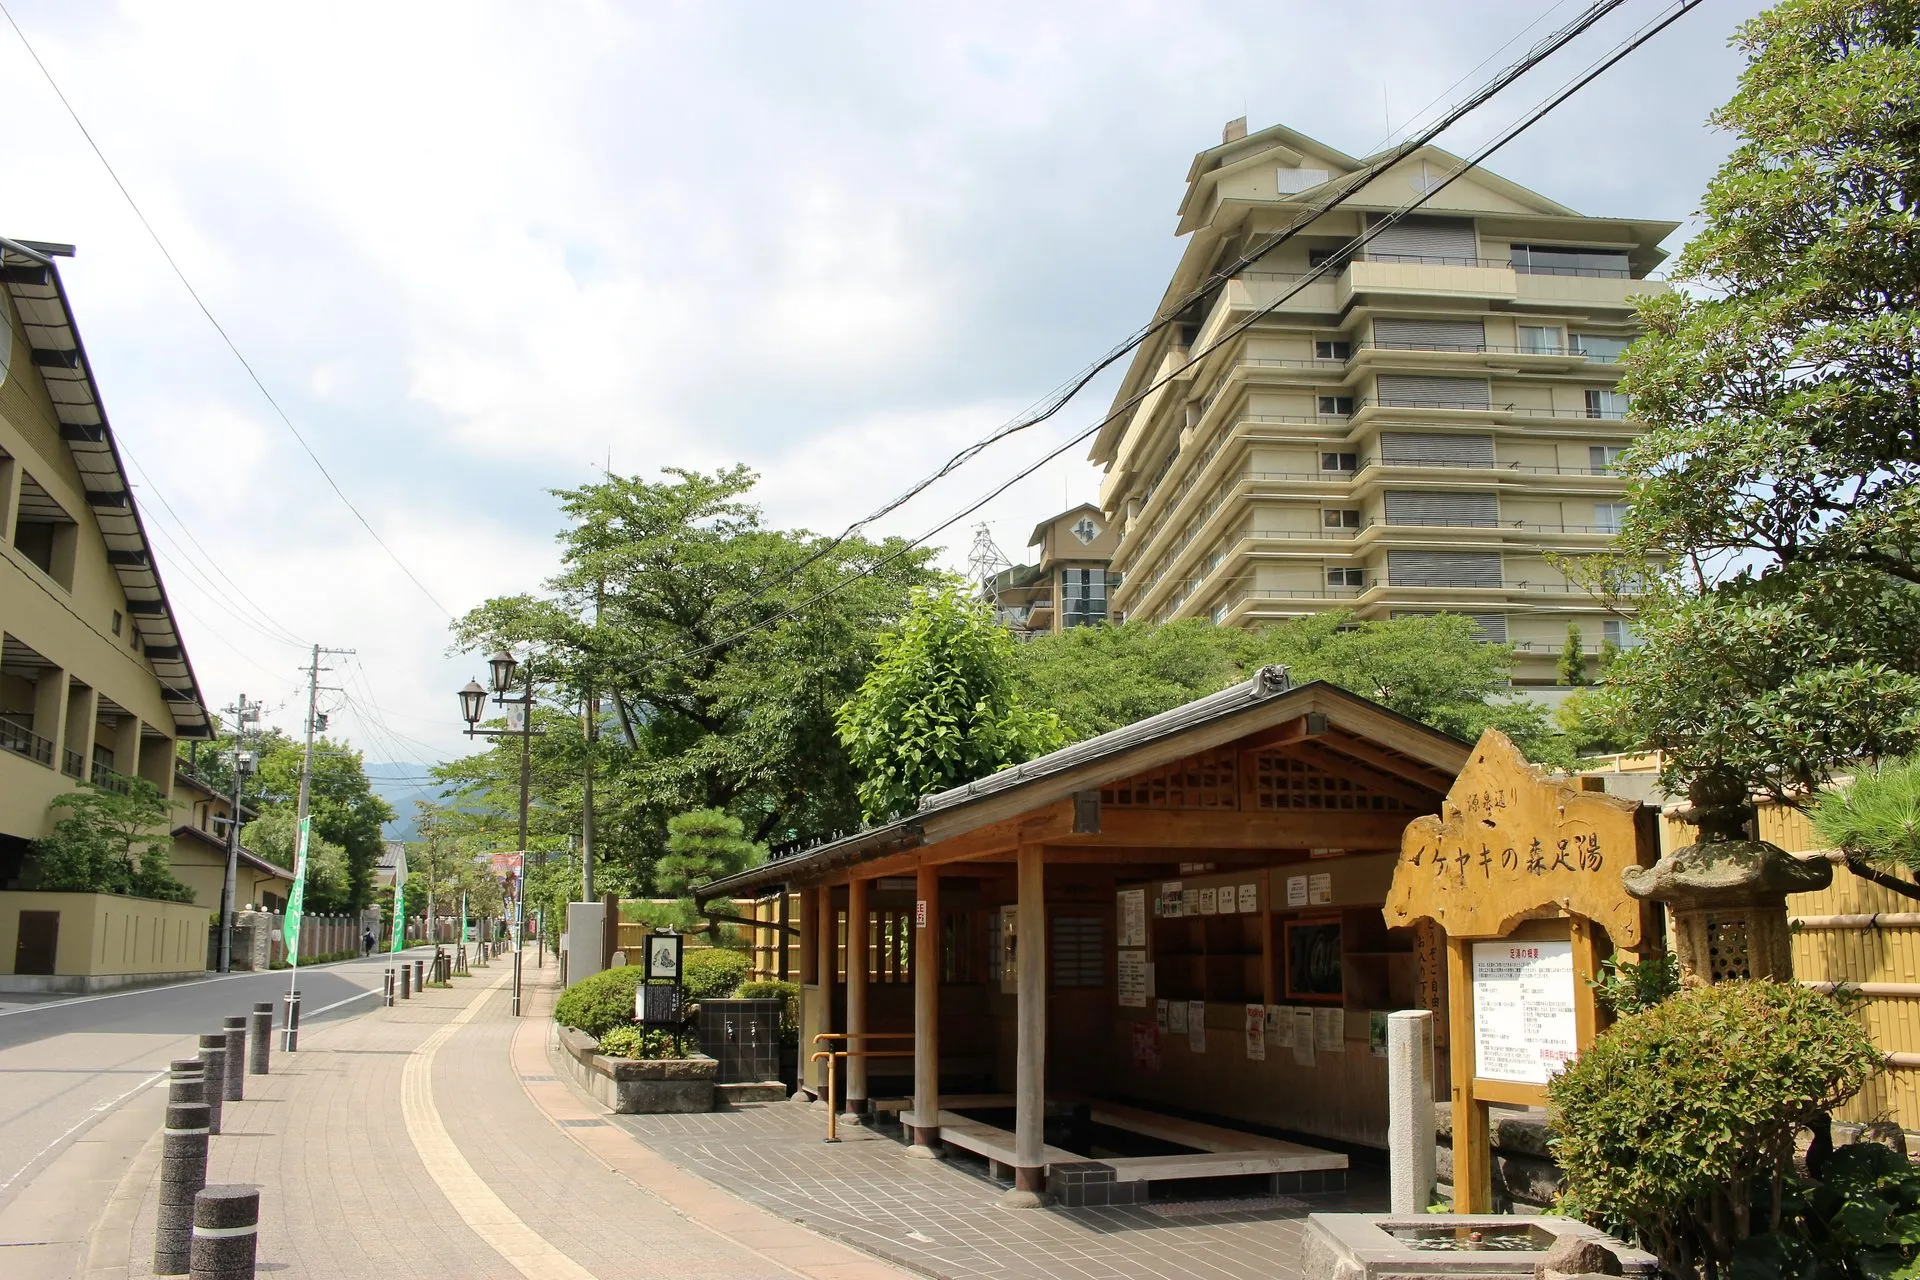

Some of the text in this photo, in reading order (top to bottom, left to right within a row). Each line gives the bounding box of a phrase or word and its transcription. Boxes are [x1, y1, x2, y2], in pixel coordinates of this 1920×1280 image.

[1431, 832, 1603, 879] ケヤキの森足湯
[1415, 934, 1427, 1010] お入り下さ
